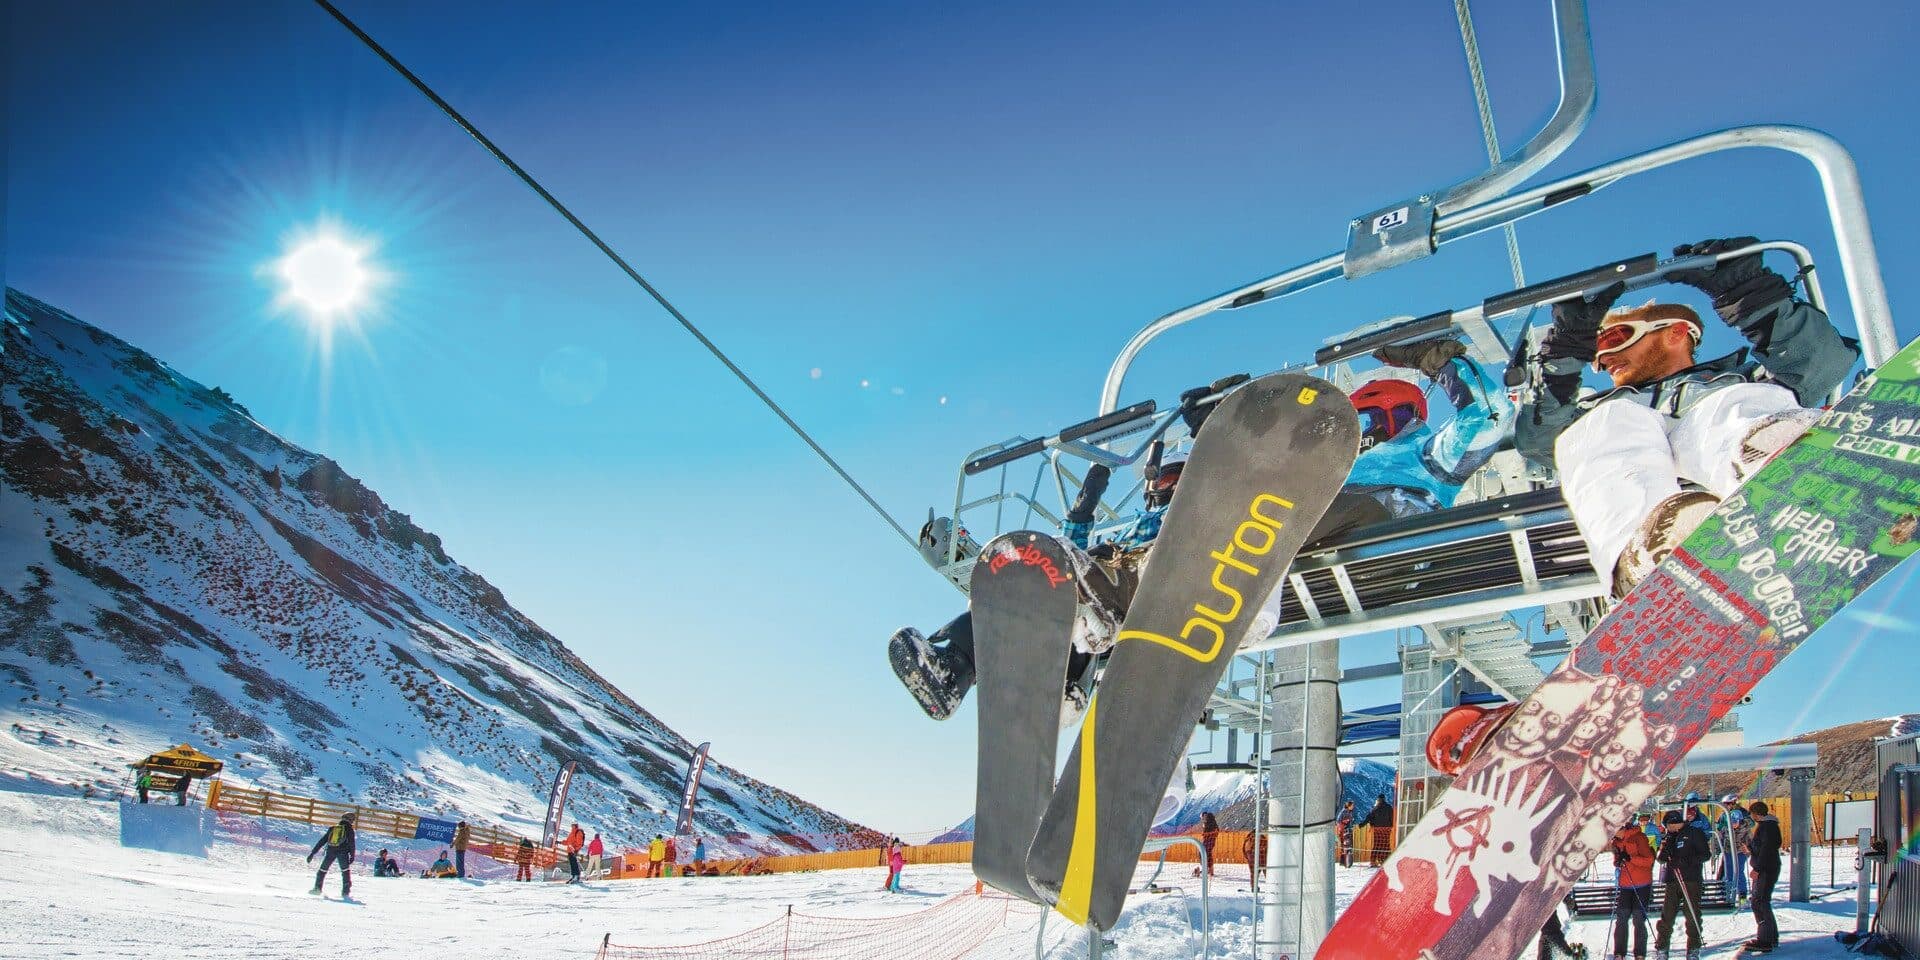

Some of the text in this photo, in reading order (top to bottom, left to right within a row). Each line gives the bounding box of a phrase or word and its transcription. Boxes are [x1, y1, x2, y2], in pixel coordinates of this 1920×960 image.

[1379, 212, 1399, 227] 61
[1836, 435, 1900, 458] PURA
[1717, 494, 1759, 548] PUSH
[1770, 504, 1836, 536] HELP
[1118, 493, 1294, 663] burton
[1783, 530, 1879, 578] OTHERS
[1664, 560, 1744, 623] COMES AROUND
[550, 769, 569, 822] HEAD
[683, 754, 702, 810] HEAD
